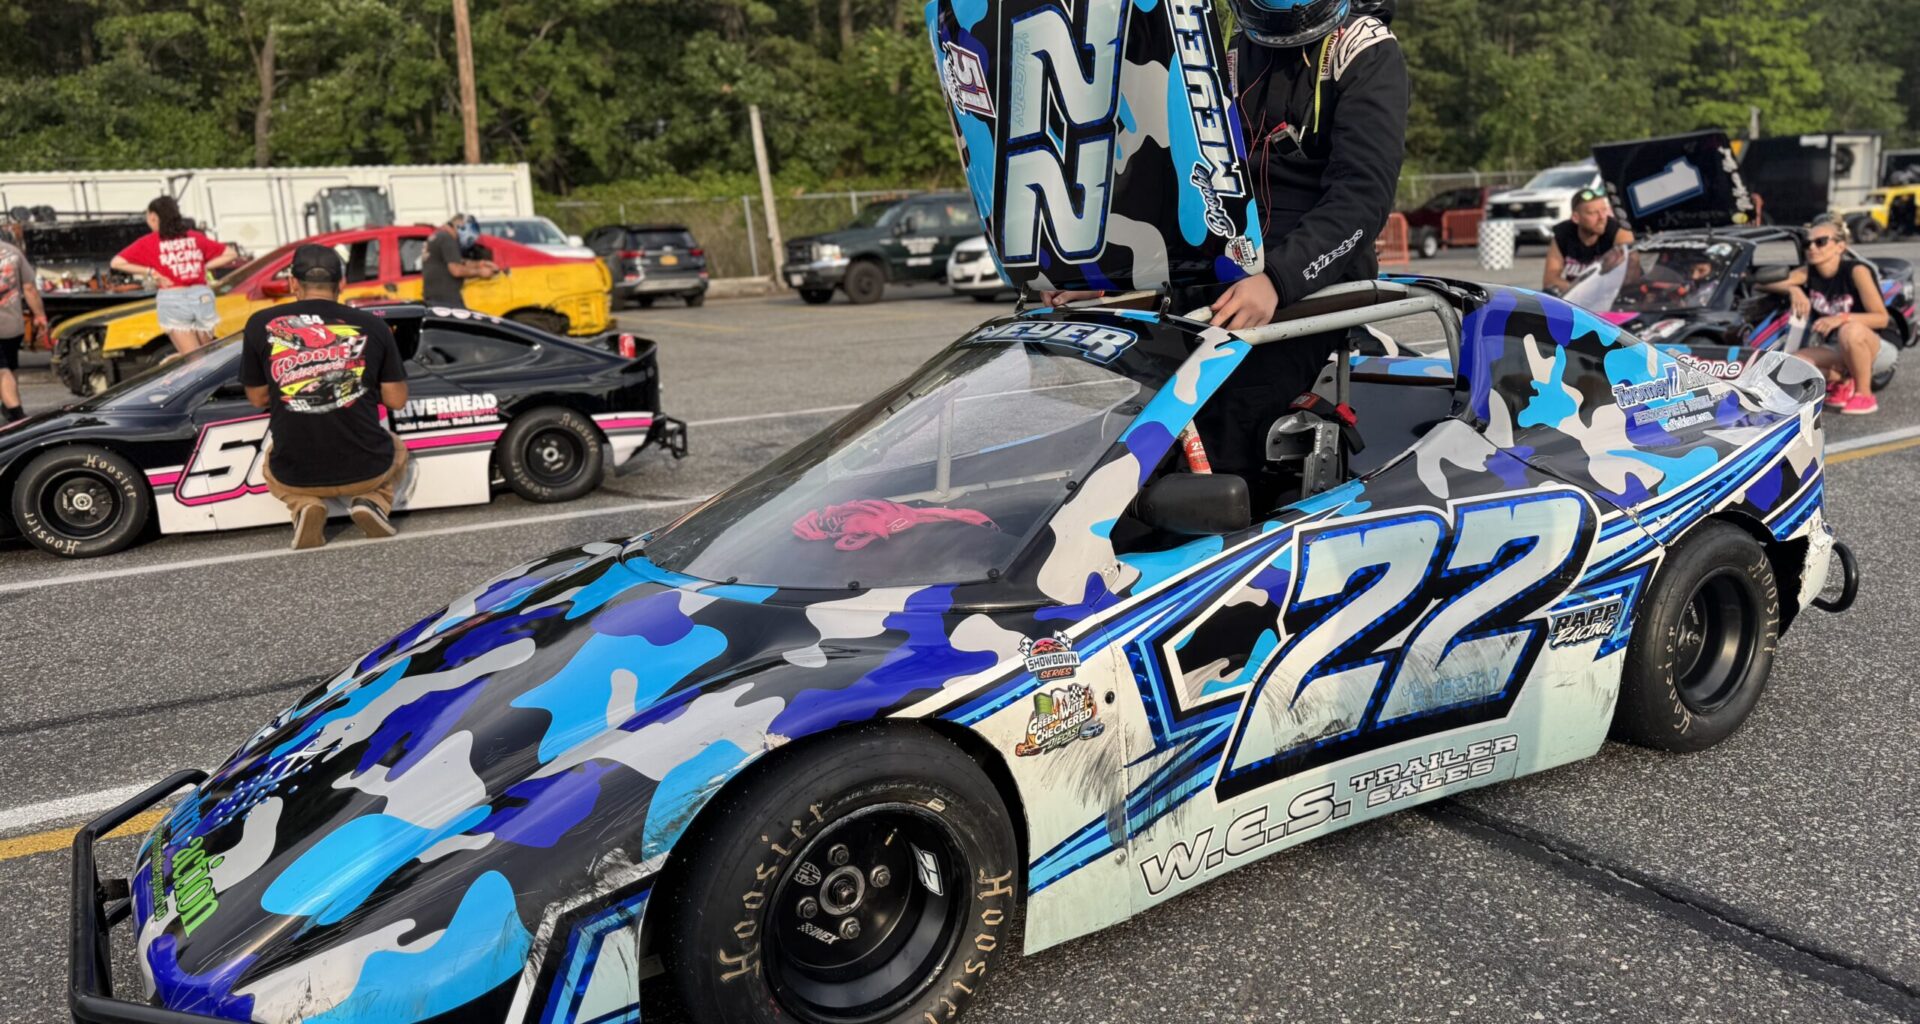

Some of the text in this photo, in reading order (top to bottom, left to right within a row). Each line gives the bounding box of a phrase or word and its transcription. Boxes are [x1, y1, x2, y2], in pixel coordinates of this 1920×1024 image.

[1171, 0, 1242, 195] MEYER
[997, 0, 1122, 263] 22
[1192, 163, 1235, 237] Brooke
[159, 237, 196, 253] MISFIT
[159, 249, 203, 266] RACING
[1240, 237, 1252, 264] FEATURE
[169, 262, 202, 278] TEAM
[966, 322, 1133, 360] MEYER
[271, 344, 352, 382] GOODIE
[394, 394, 498, 418] RIVERHEAD
[83, 454, 137, 499] Hoosier
[24, 511, 82, 555] Hoosier
[1551, 602, 1621, 635] RAPP
[1552, 619, 1615, 646] RACING
[1028, 653, 1078, 670] SHOWDOWN
[1220, 488, 1592, 800] 22
[1040, 667, 1072, 679] SERIES
[1028, 711, 1058, 735] GREEN
[1035, 708, 1092, 745] CHECKERED
[1350, 735, 1518, 796] TRAILER
[1367, 757, 1496, 808] SALES
[1142, 784, 1350, 896] W.E.S.
[172, 836, 225, 937] action
[719, 800, 824, 983] Hoosier
[809, 925, 840, 944] INEX
